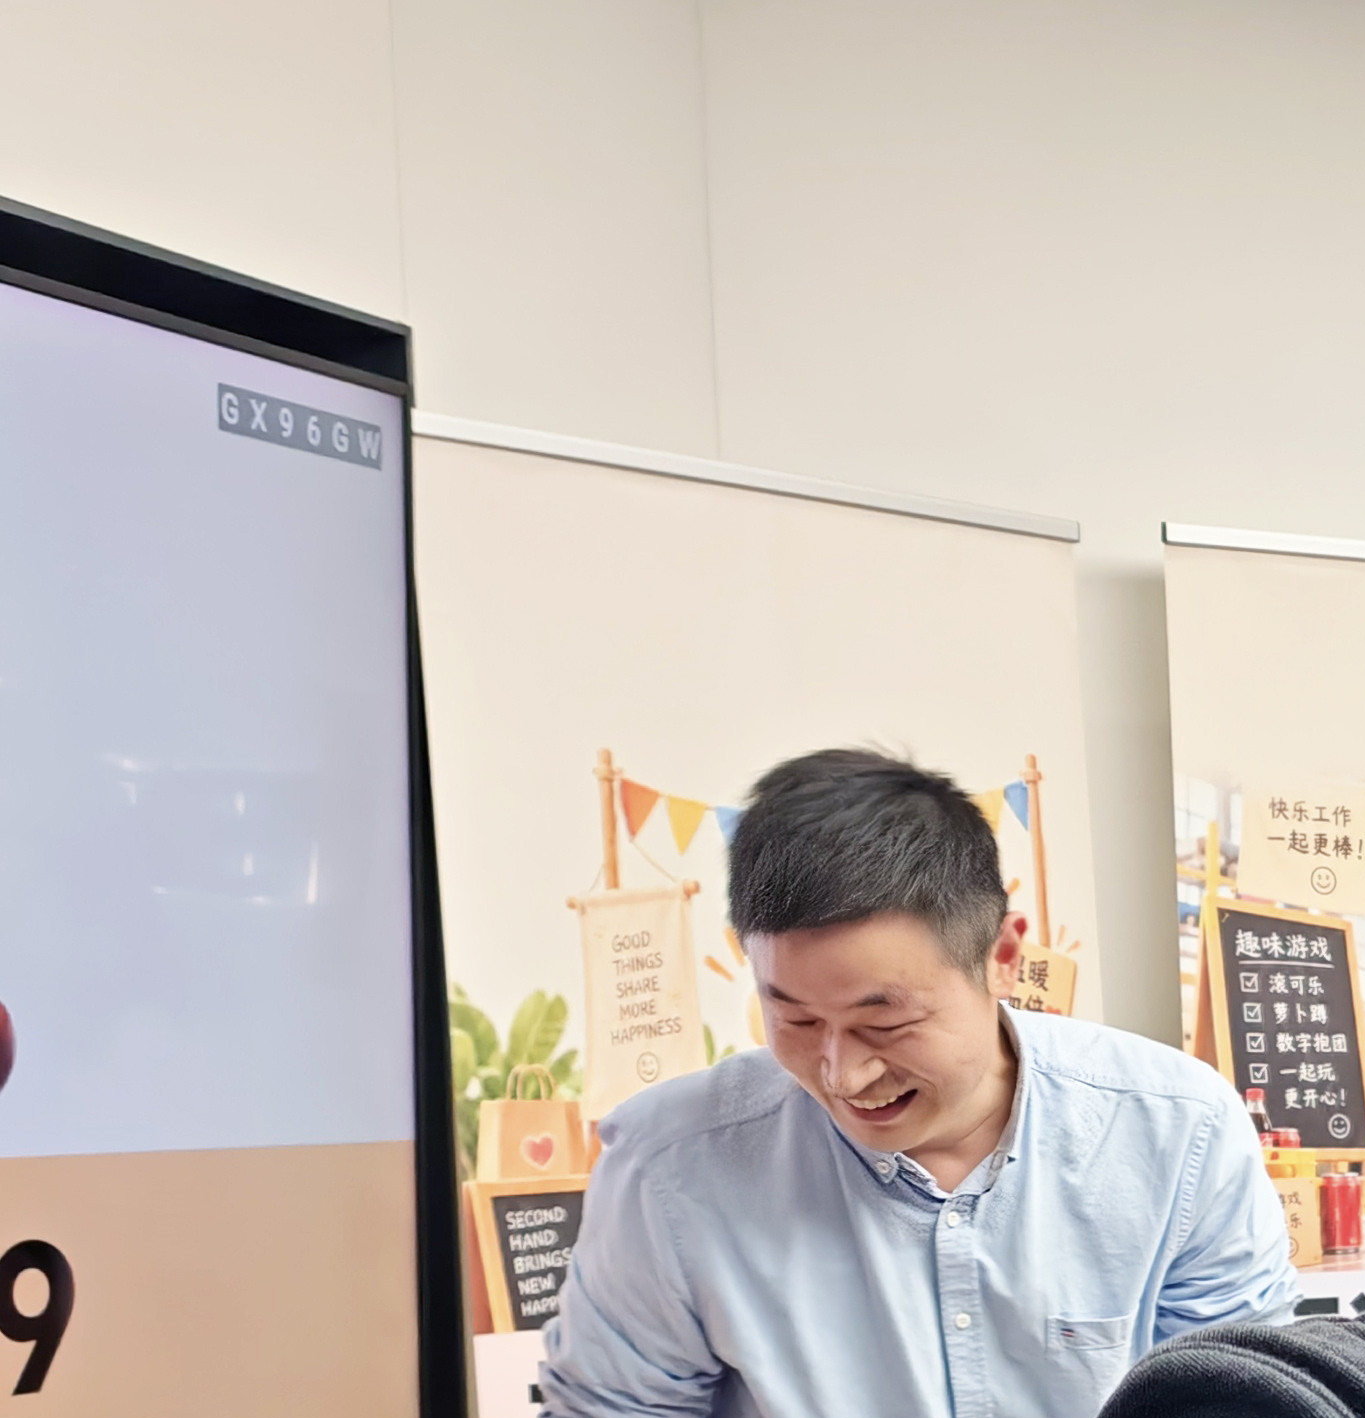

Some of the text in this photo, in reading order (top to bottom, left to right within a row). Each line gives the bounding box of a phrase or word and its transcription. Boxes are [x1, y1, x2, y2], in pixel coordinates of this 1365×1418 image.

[221, 392, 380, 460] GX96GW
[1269, 797, 1351, 827] 快乐工作
[611, 930, 651, 953] GOOD
[1235, 930, 1333, 961] 趣味游戏
[612, 952, 664, 975] THINGS
[1018, 955, 1048, 991] 暖
[616, 975, 660, 999] SHARE
[1269, 972, 1325, 995] 滚可乐
[619, 999, 657, 1021] MORE
[1273, 1001, 1328, 1025] 萝卜蹲
[611, 1017, 682, 1045] HAPPINESS
[1276, 1032, 1348, 1053] 数字抱团
[1279, 1062, 1336, 1082] 一起玩
[505, 1206, 567, 1230] SECOND
[509, 1229, 559, 1251] HAND
[513, 1247, 572, 1274] BRINGS
[517, 1272, 556, 1295] NEW
